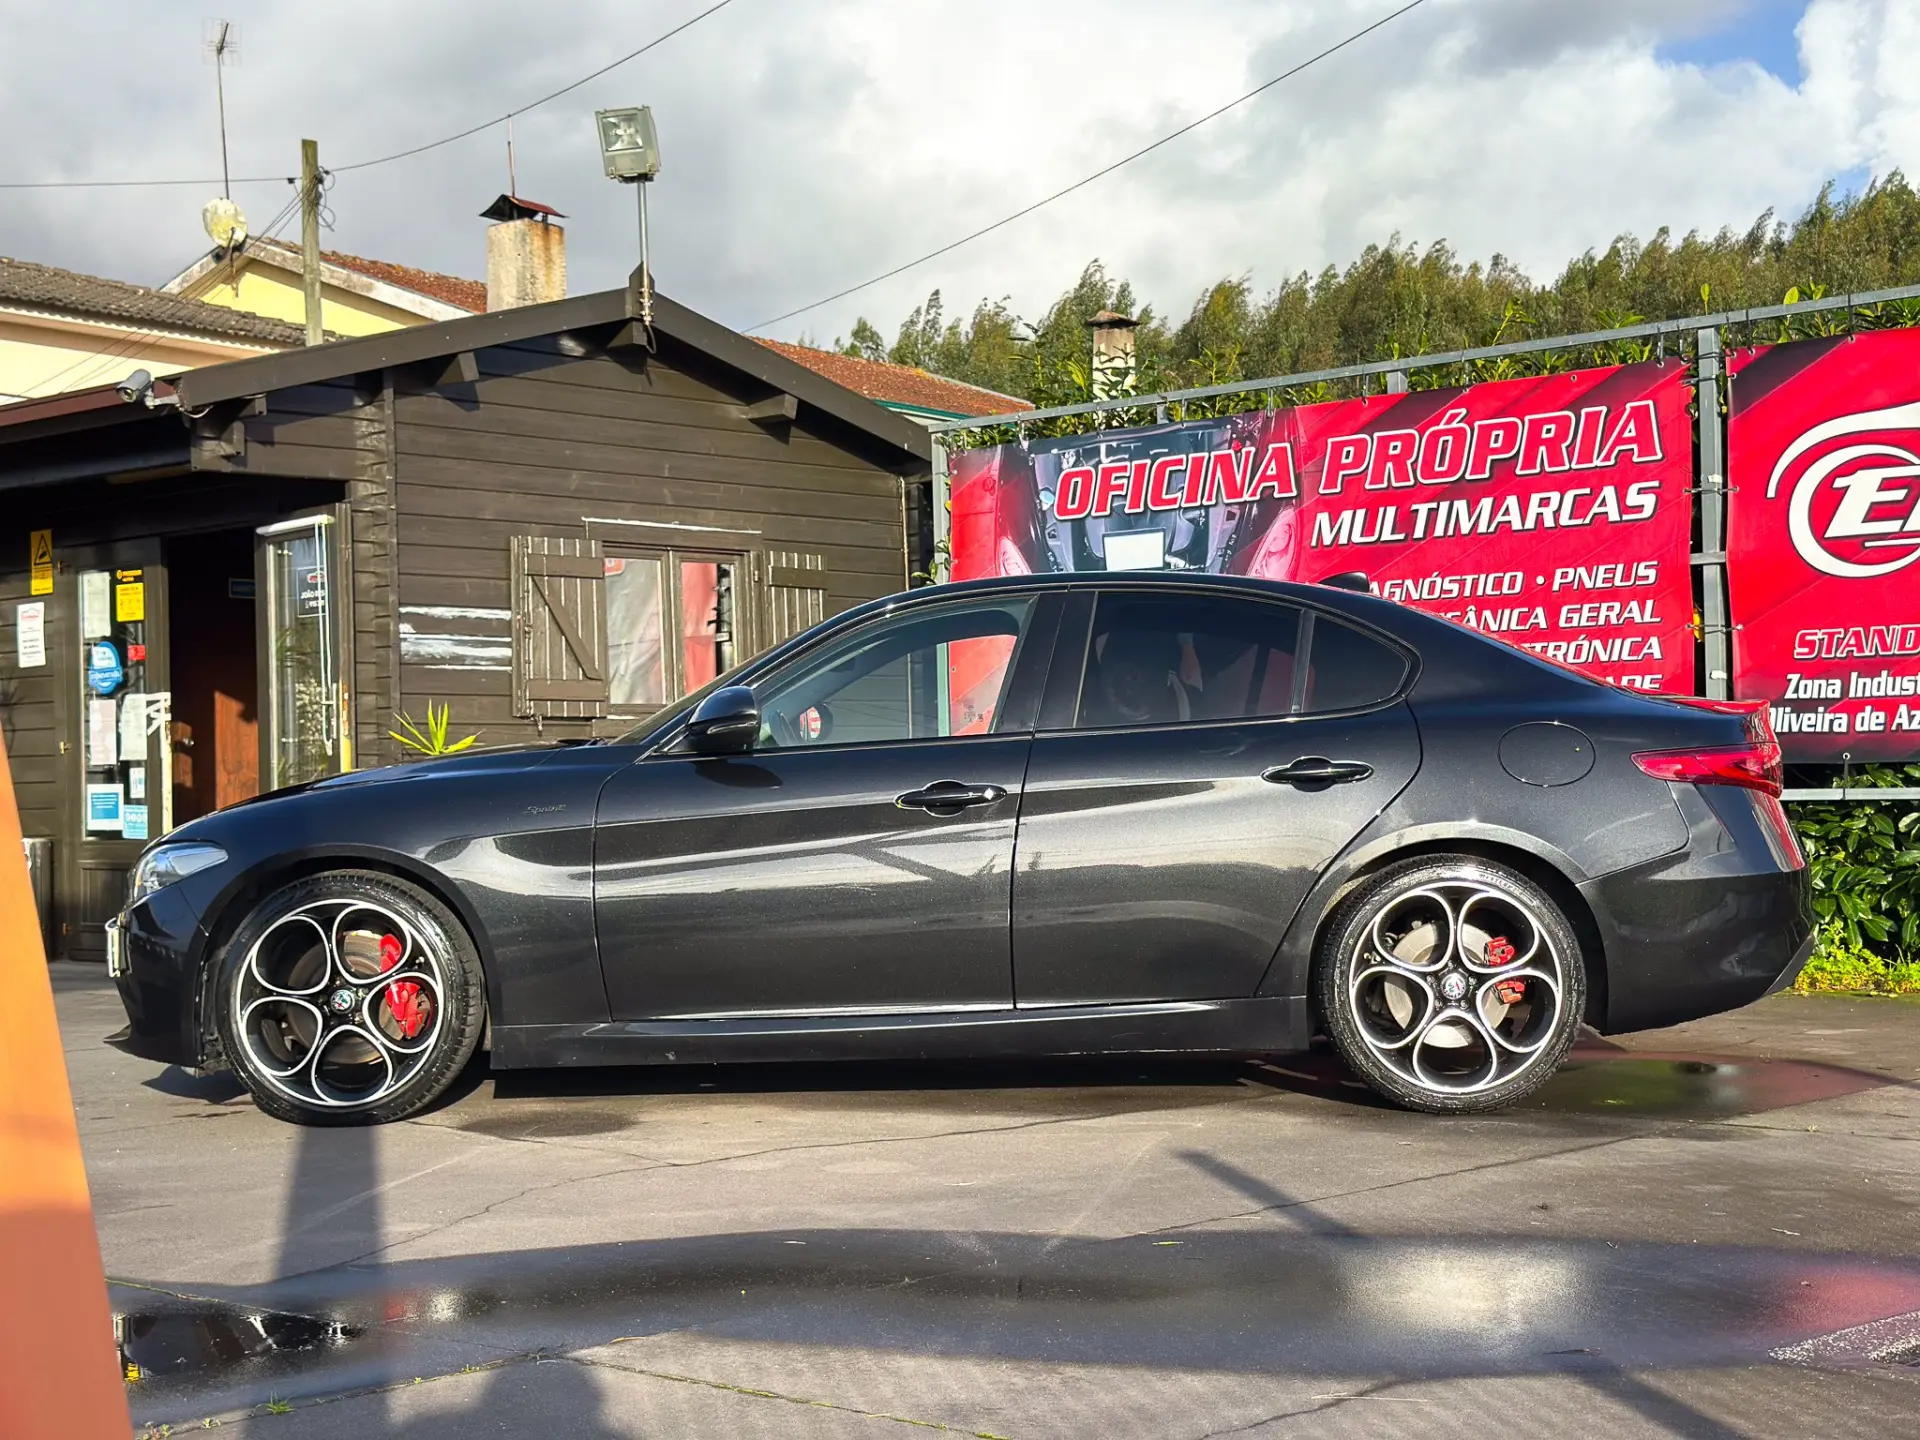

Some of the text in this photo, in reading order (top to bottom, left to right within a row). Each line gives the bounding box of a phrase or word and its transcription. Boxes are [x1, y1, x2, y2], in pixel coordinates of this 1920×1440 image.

[1054, 400, 1663, 520] OFICINA PRÓPRIA
[1310, 480, 1660, 547] MULTIMARCAS
[1552, 561, 1657, 592] PNEUS
[1559, 600, 1662, 629] GERAL
[1794, 624, 1920, 659] STAND
[1784, 673, 1842, 699] Zona
[1855, 705, 1885, 732] de
